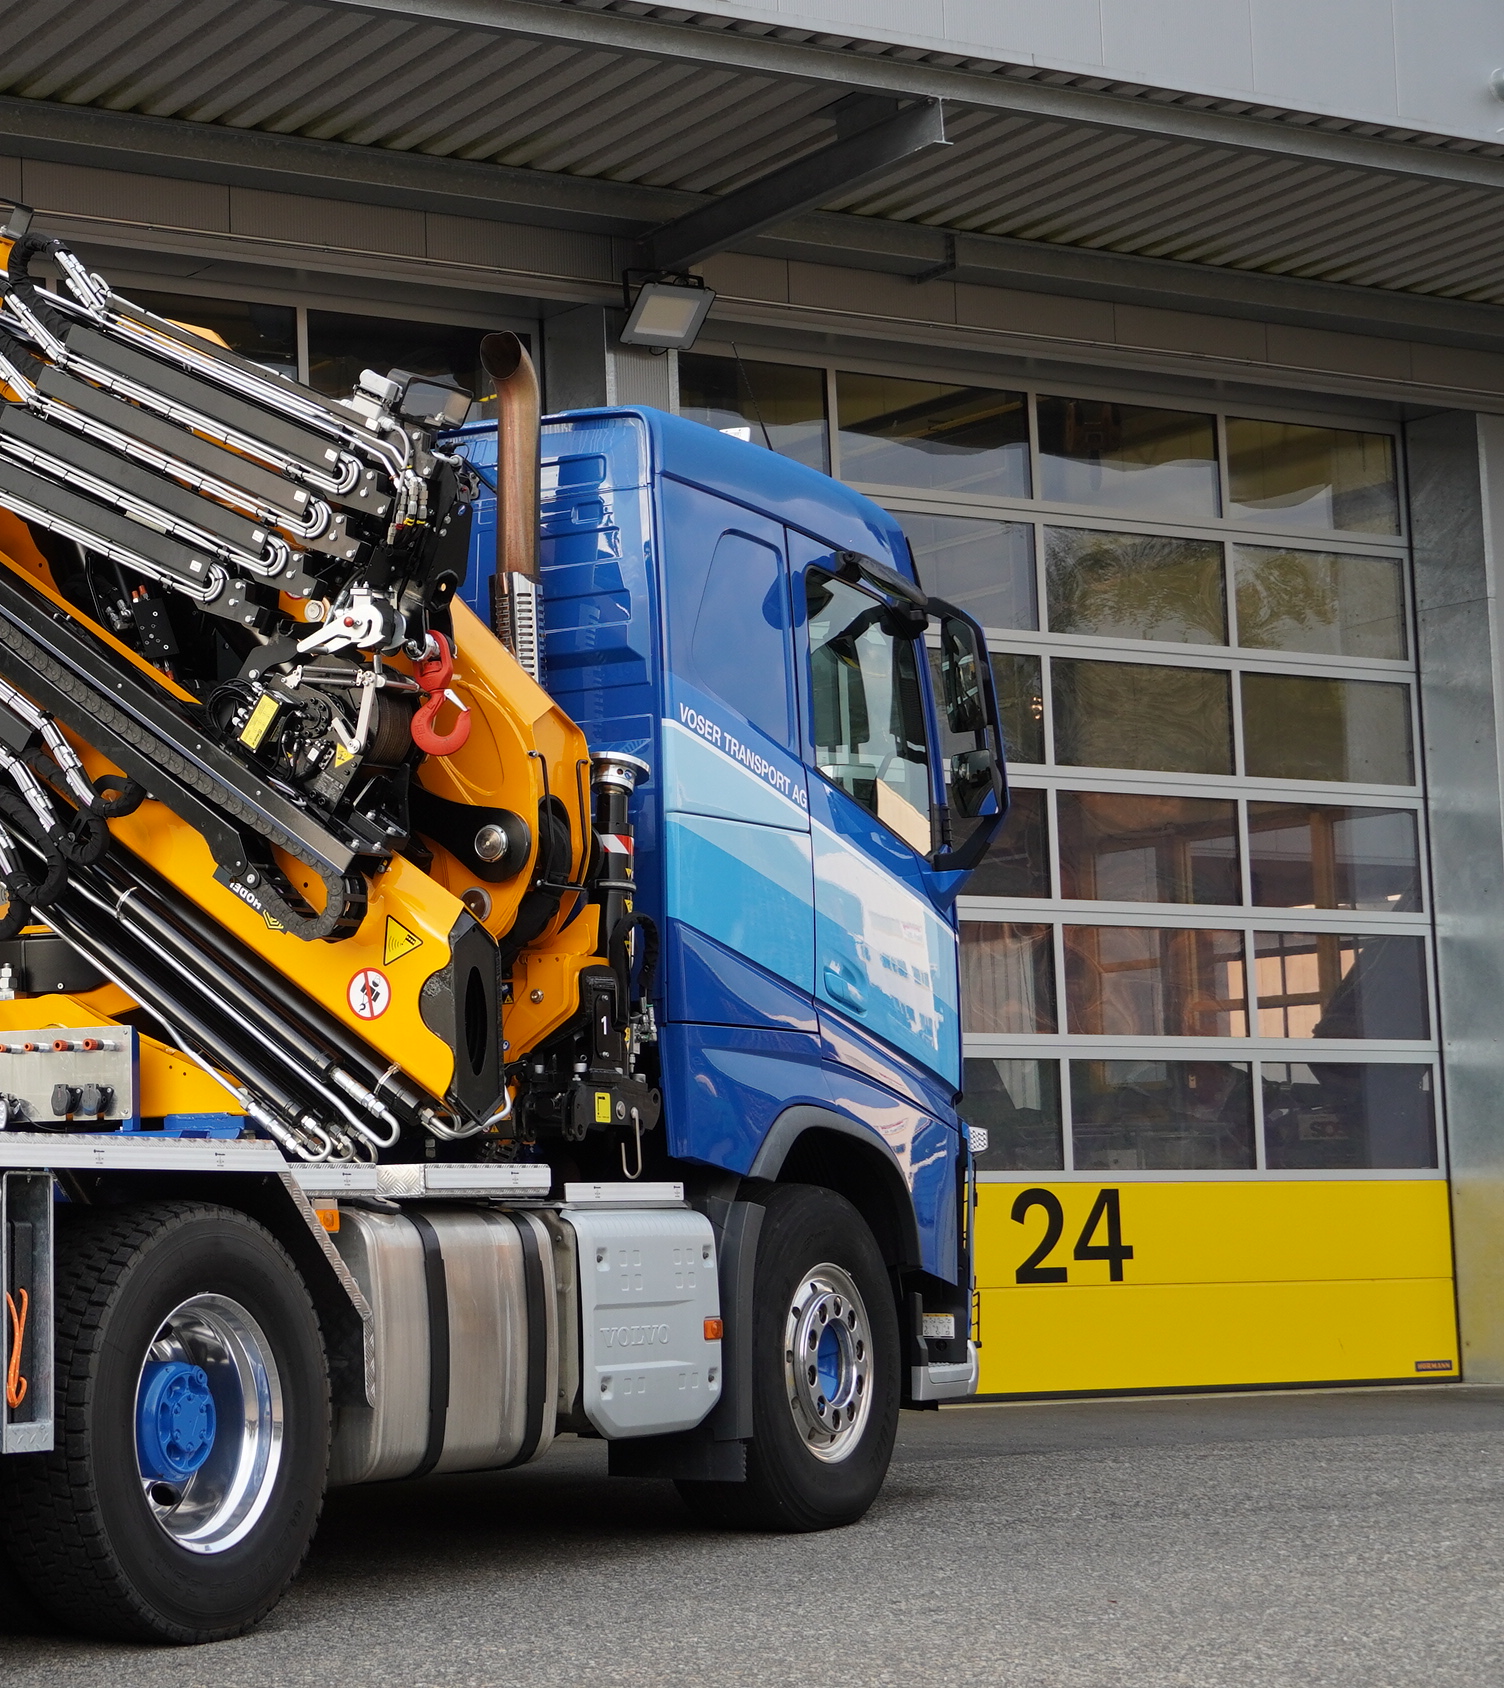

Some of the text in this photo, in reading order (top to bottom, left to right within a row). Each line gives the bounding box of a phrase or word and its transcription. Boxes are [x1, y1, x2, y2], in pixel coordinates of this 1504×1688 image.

[679, 703, 808, 810] VOSER TRANSPORT AG
[601, 1016, 608, 1036] 1
[1010, 1187, 1134, 1285] 24
[599, 1323, 671, 1348] VOLVO
